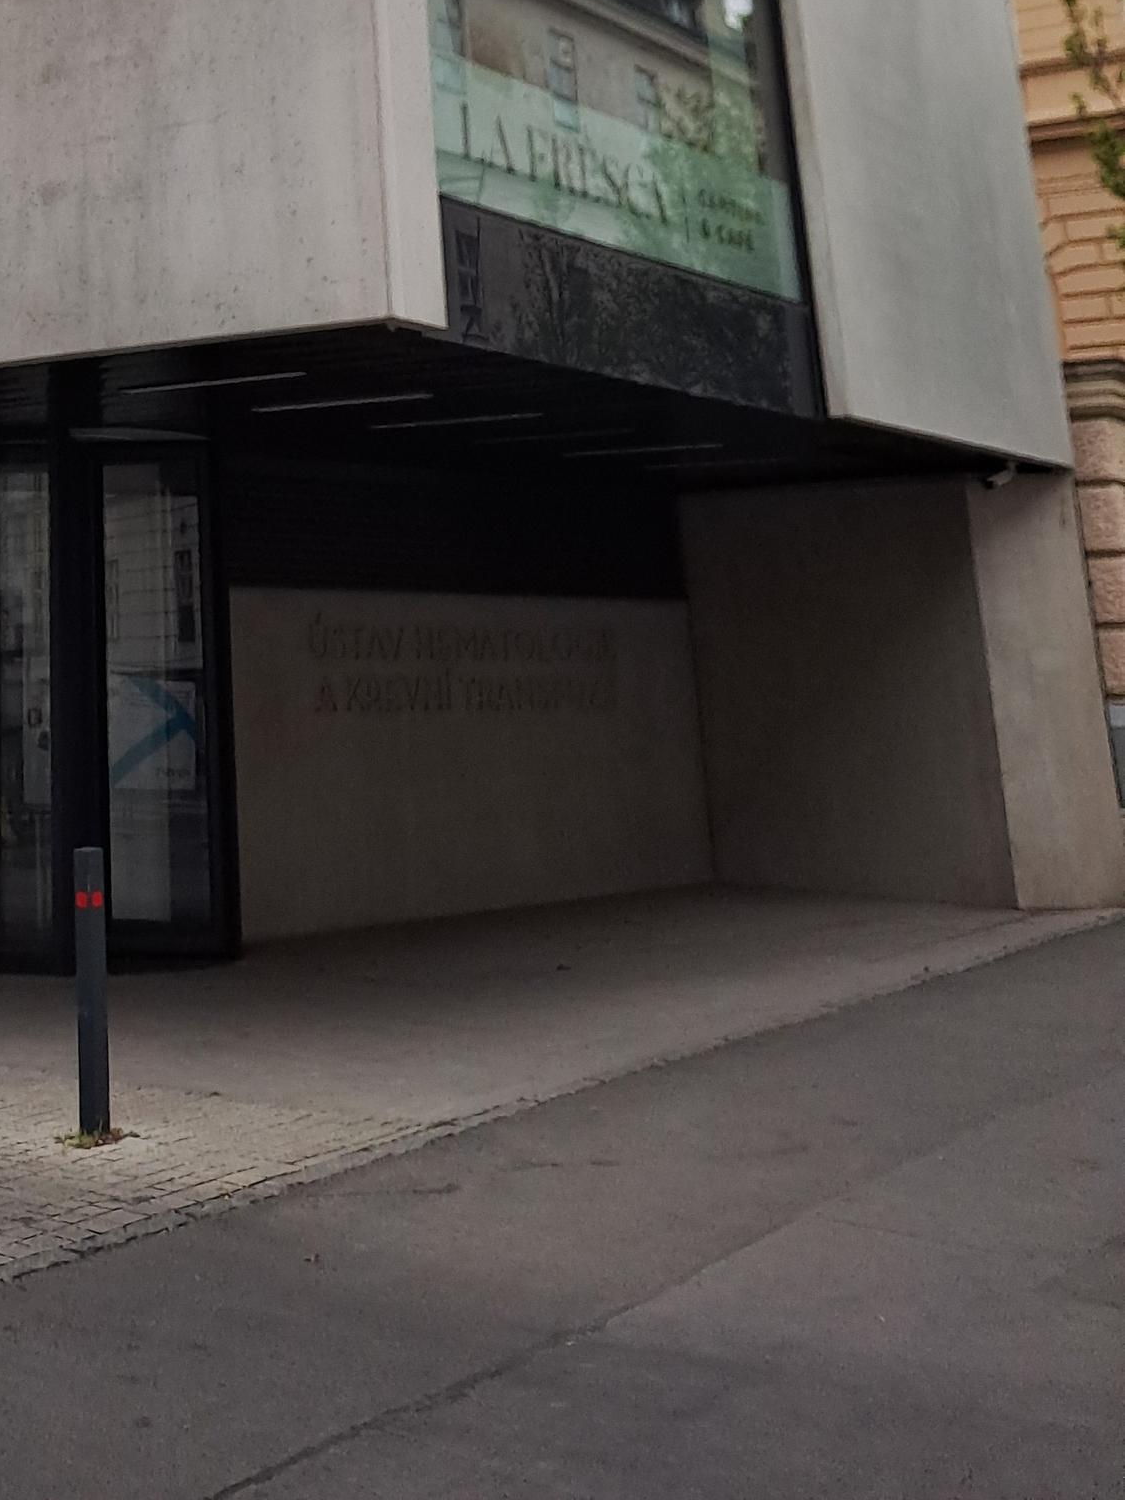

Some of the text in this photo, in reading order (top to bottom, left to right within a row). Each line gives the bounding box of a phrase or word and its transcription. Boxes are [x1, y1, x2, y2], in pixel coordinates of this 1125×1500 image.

[461, 100, 669, 228] LA FRESCA
[307, 611, 405, 659] ÚSTAV
